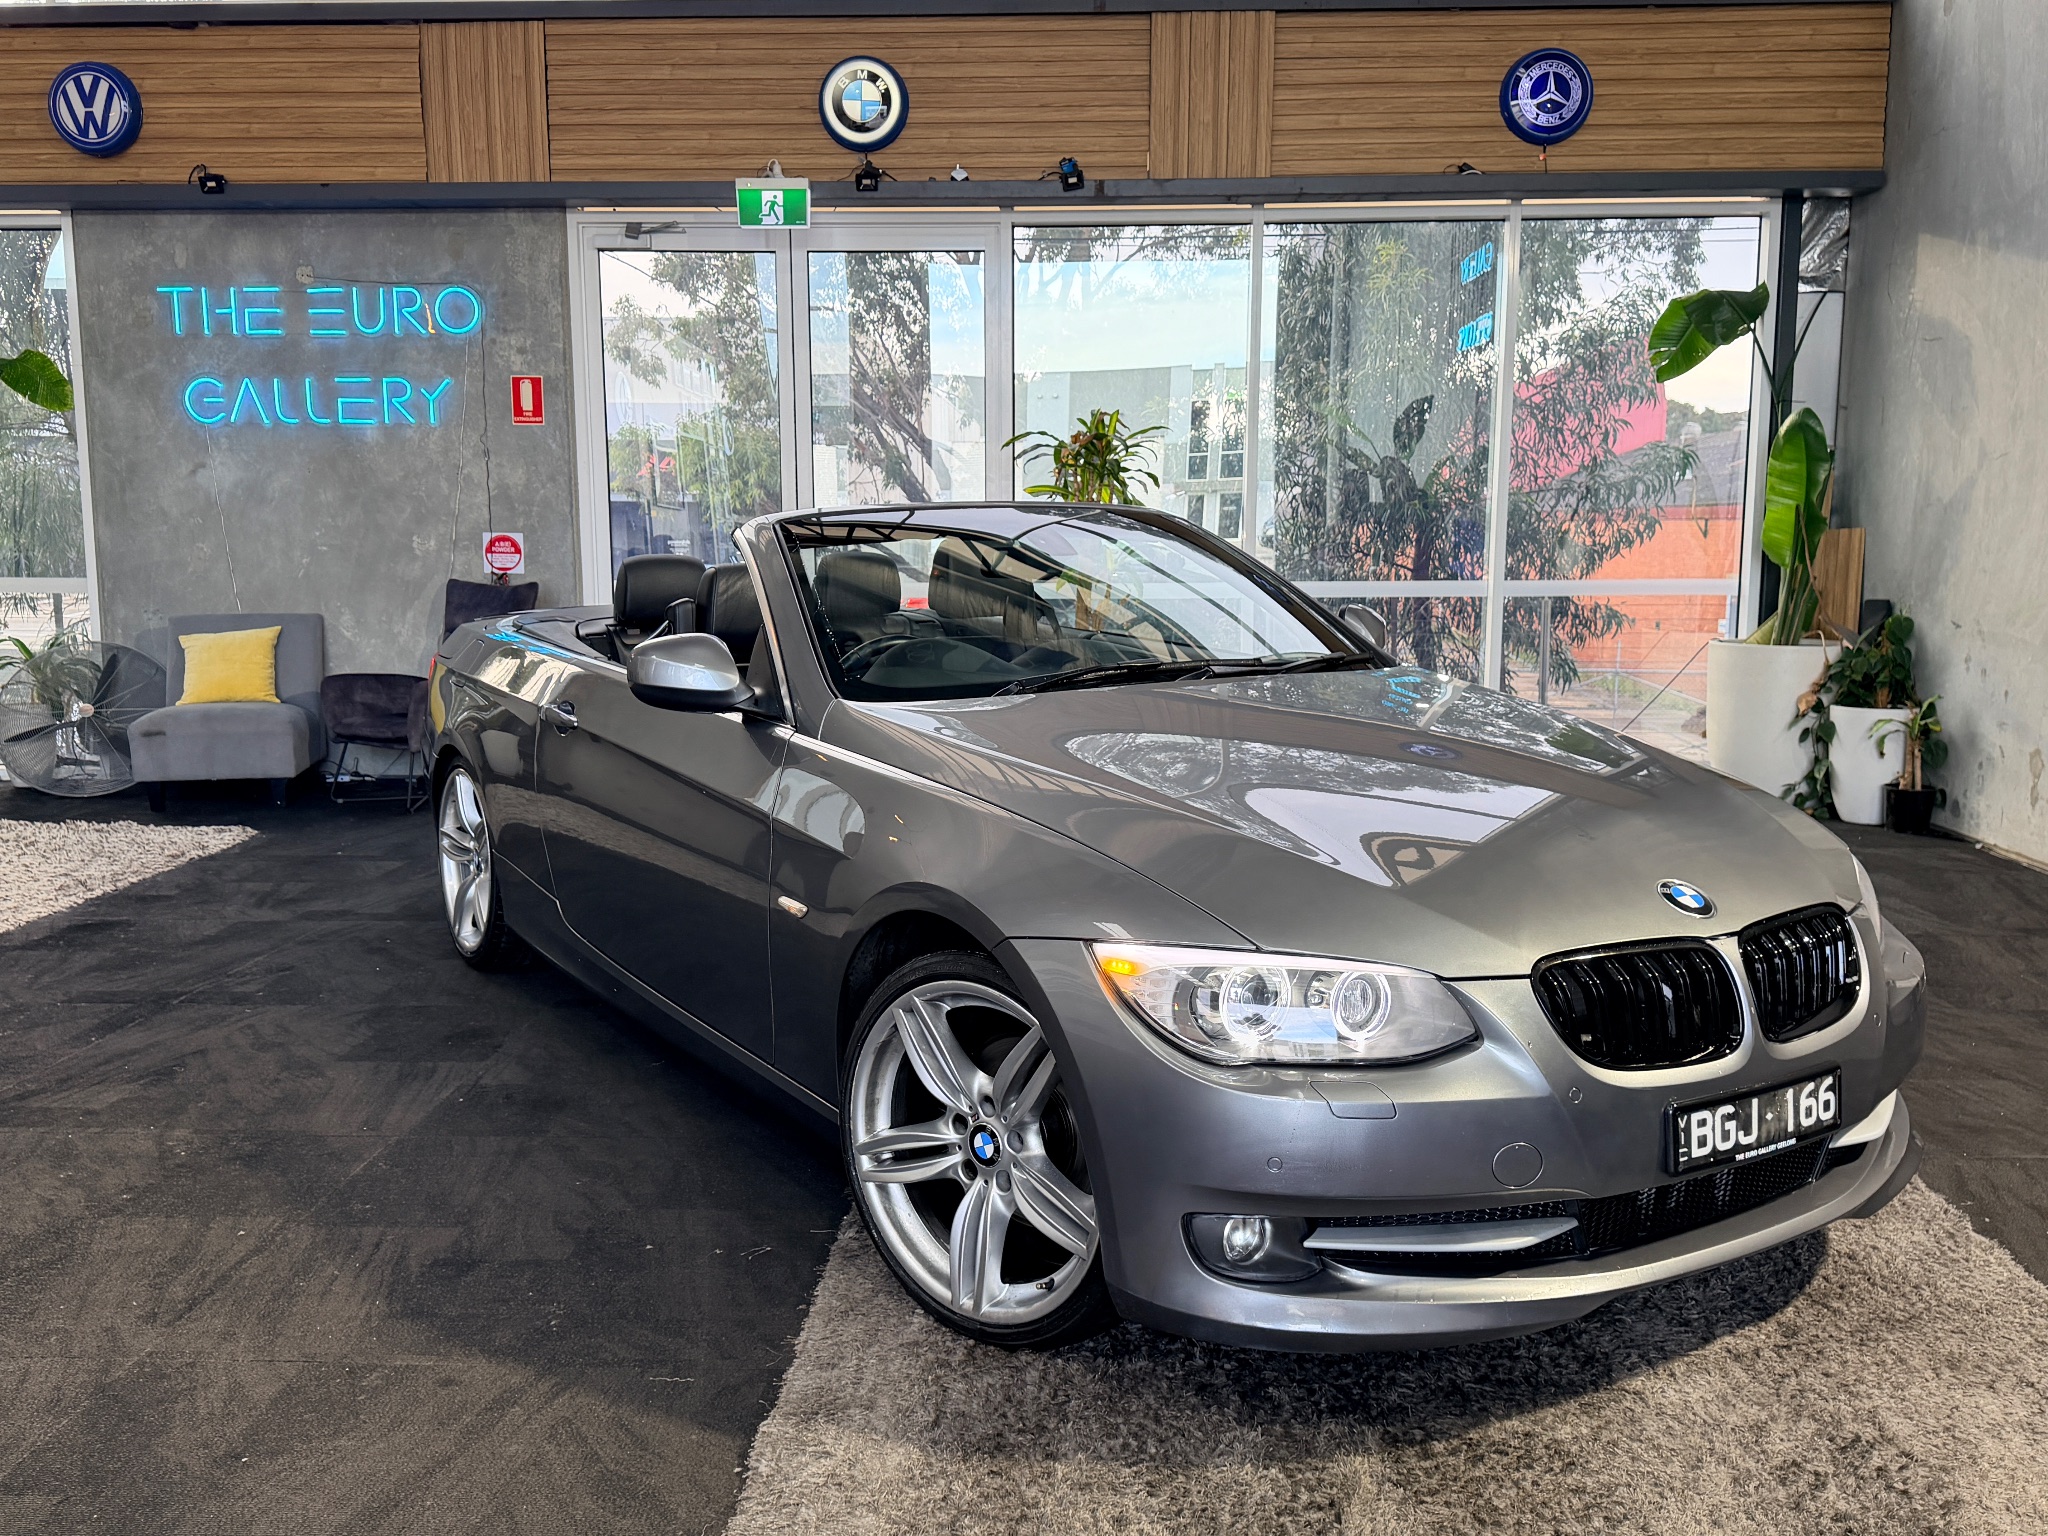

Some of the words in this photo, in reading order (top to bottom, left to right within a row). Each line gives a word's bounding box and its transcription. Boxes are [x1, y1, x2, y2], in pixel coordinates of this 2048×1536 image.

[838, 69, 888, 92] BMW
[1529, 62, 1574, 79] MERCEDES
[1537, 114, 1561, 125] BENZ
[156, 286, 284, 335] THE
[306, 286, 481, 336] EURO
[184, 376, 453, 425] GALLERY
[1690, 1097, 1759, 1159] BGJ
[1786, 1075, 1836, 1133] 166
[1735, 1153, 1745, 1162] THE
[1745, 1149, 1758, 1159] EURO
[1758, 1144, 1777, 1155] GALLERY
[1777, 1137, 1797, 1150] GEELONG
